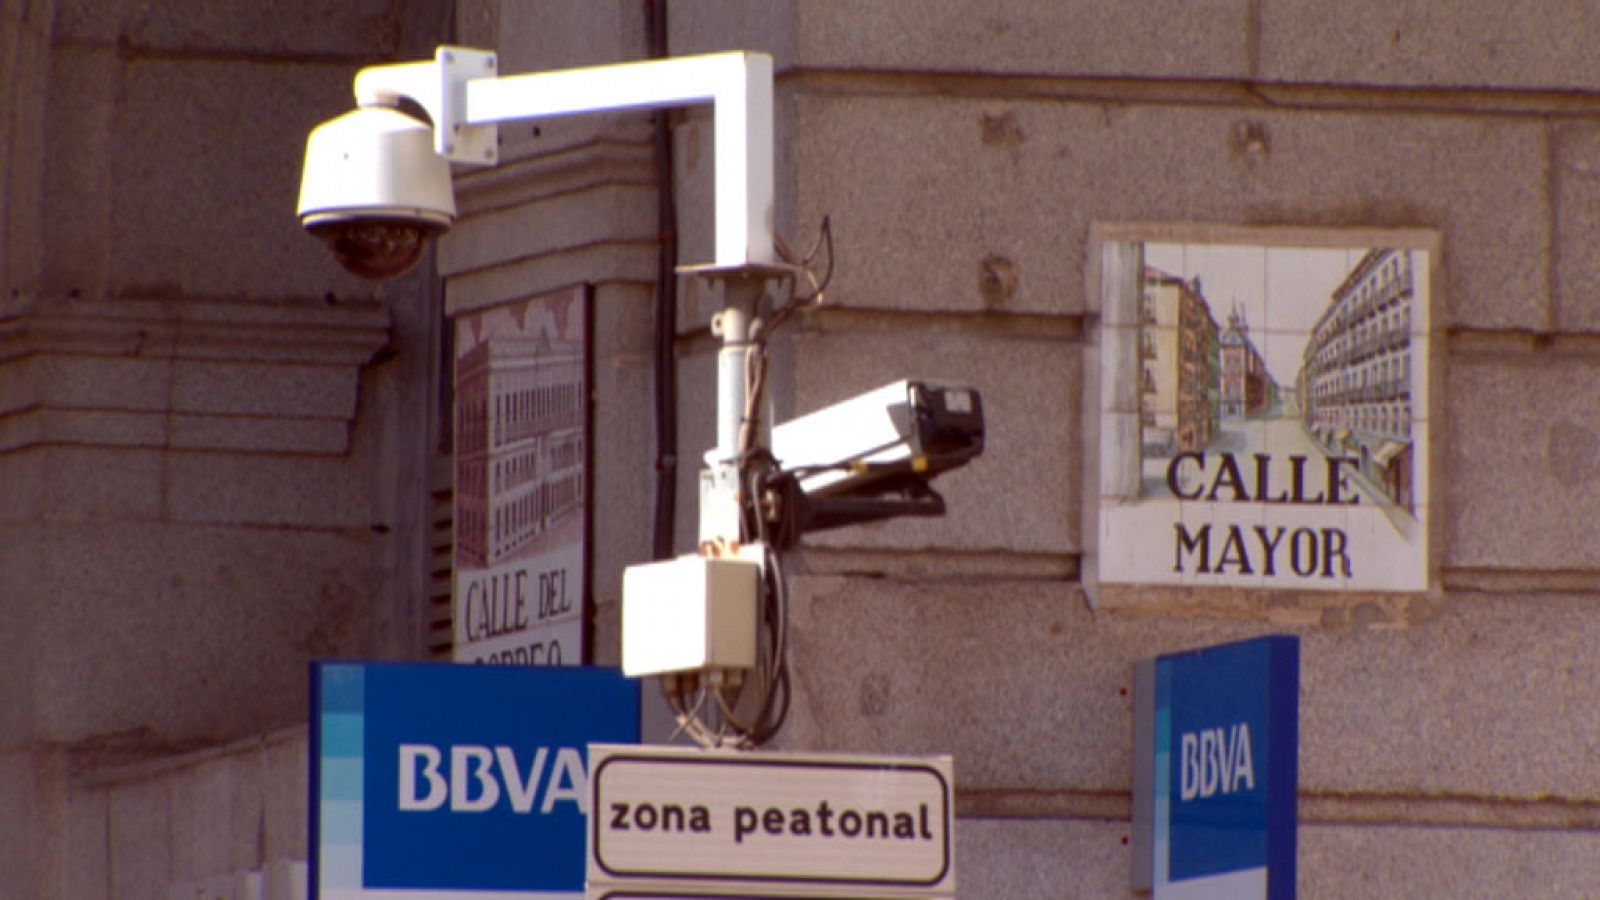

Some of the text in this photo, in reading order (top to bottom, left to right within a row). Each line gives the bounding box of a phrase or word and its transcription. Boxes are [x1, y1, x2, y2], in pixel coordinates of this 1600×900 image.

[1167, 451, 1360, 504] CALLE
[1173, 522, 1352, 578] MAYOR
[465, 569, 571, 642] CALLE DEL
[398, 744, 587, 814] BBVA
[1181, 722, 1254, 801] BBVA
[610, 800, 933, 843] zona peatonal
